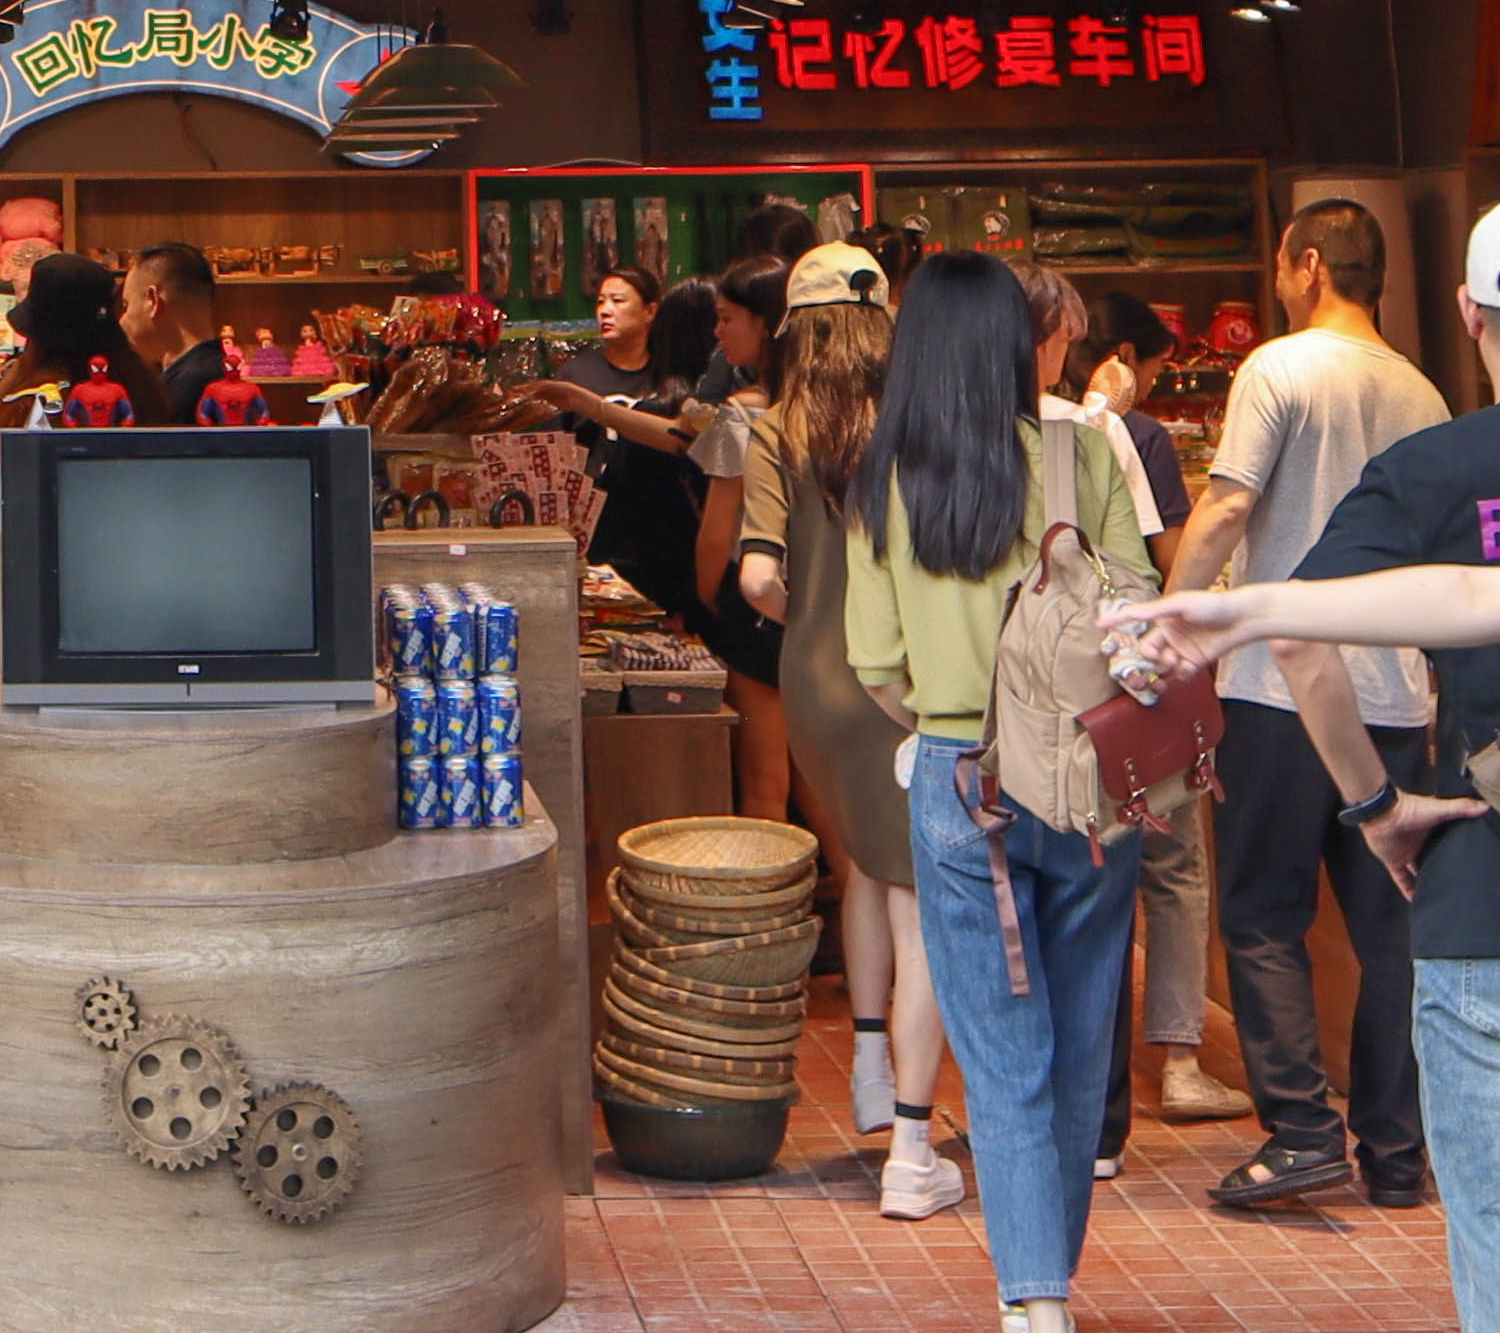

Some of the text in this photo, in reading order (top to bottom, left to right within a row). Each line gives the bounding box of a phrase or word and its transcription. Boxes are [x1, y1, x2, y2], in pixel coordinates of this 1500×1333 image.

[768, 13, 1207, 91] 记忆修复车间
